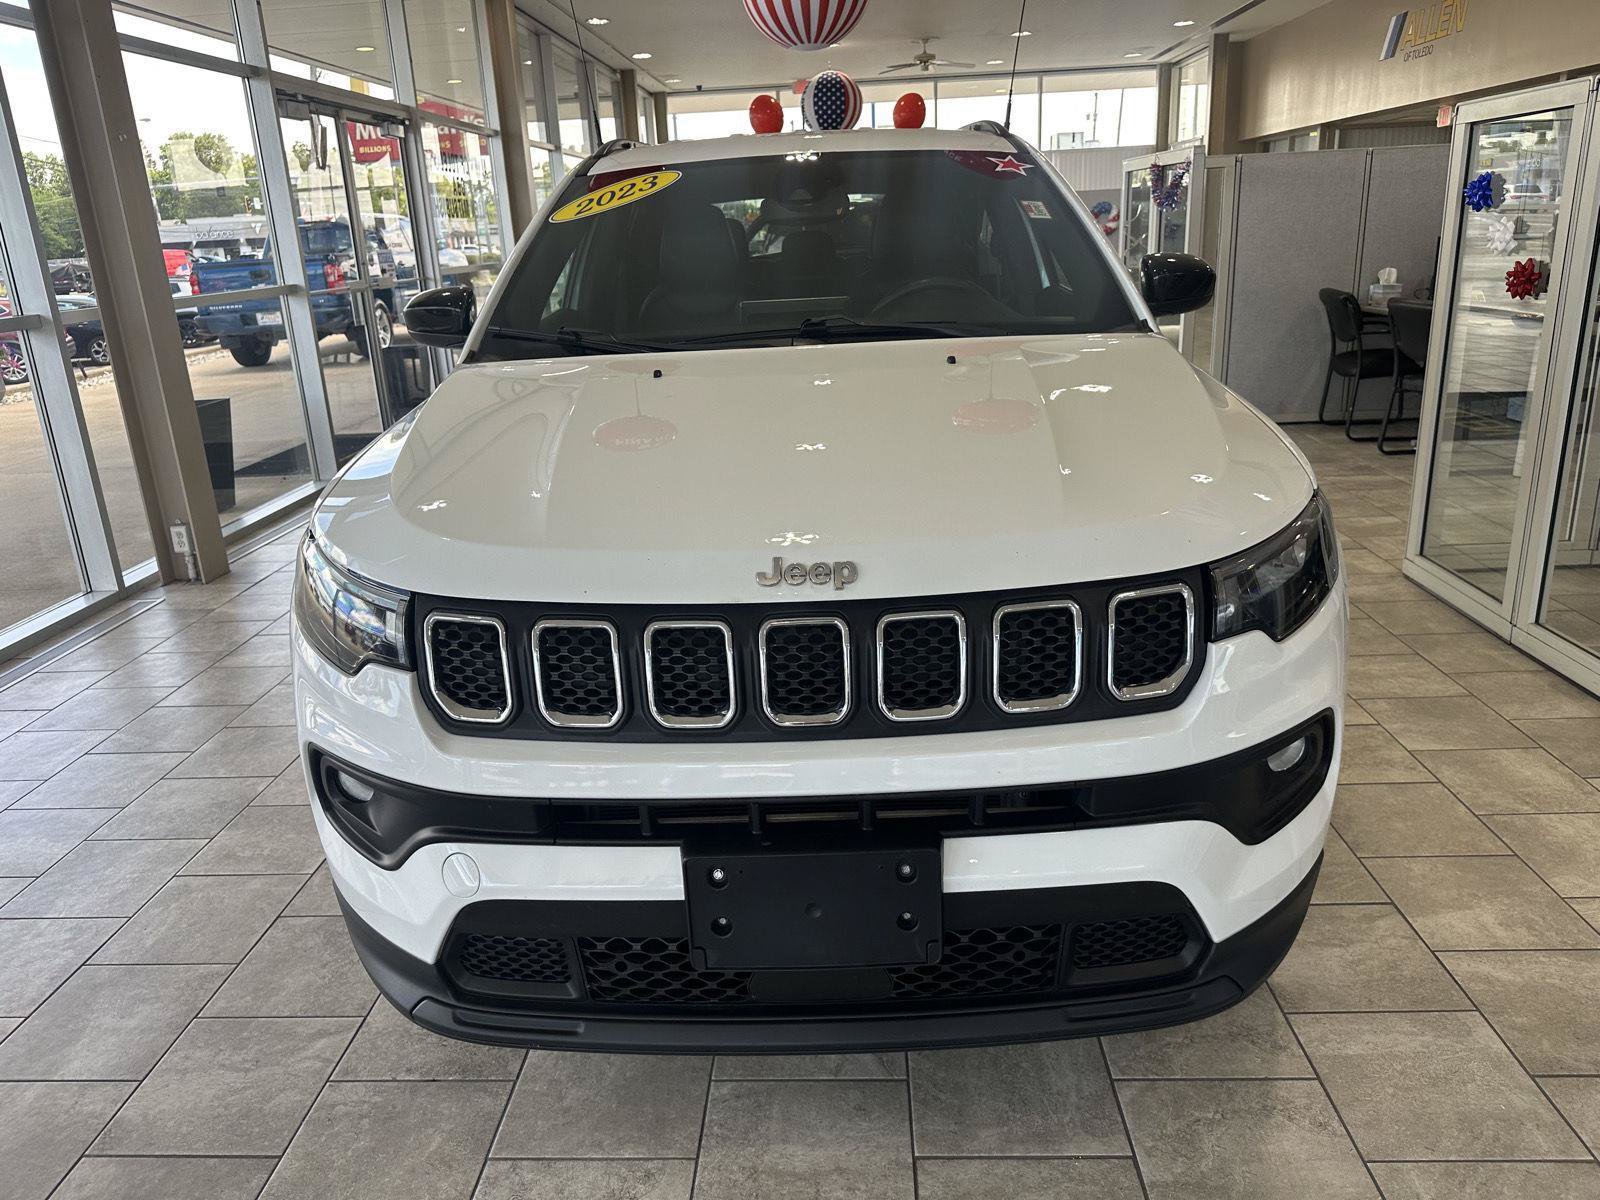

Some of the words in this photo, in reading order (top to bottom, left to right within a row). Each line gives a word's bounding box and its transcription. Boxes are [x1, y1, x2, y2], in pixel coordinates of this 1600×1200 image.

[1401, 0, 1469, 51] ALLEN
[1404, 51, 1412, 62] OF
[1412, 45, 1434, 60] TOLEDO
[359, 144, 392, 154] BILLIONS
[575, 176, 659, 216] 2023
[756, 556, 859, 591] Jeep
